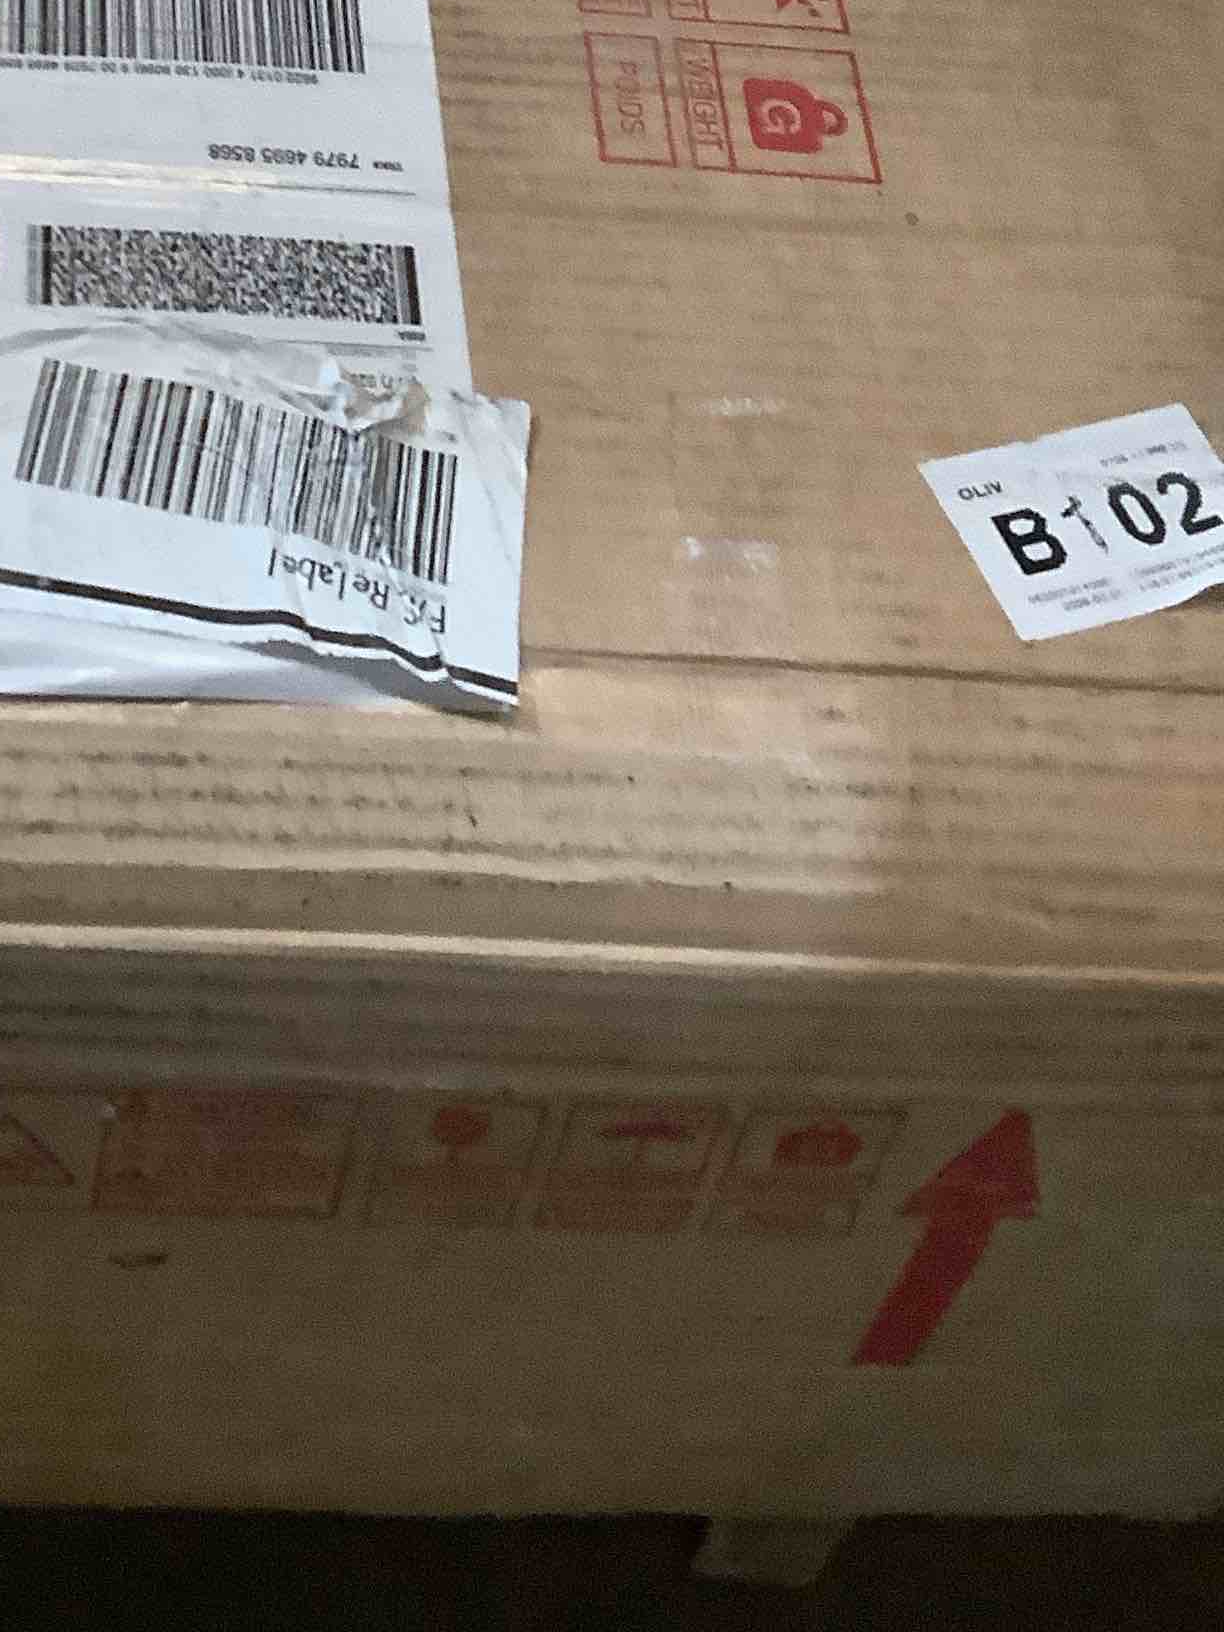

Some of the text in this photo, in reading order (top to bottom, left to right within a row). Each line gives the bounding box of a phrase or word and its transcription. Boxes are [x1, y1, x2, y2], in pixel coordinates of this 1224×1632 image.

[312, 151, 360, 170] 7979
[957, 479, 1003, 502] OLIV
[991, 471, 1224, 576] B102
[267, 546, 390, 611] Relabel
